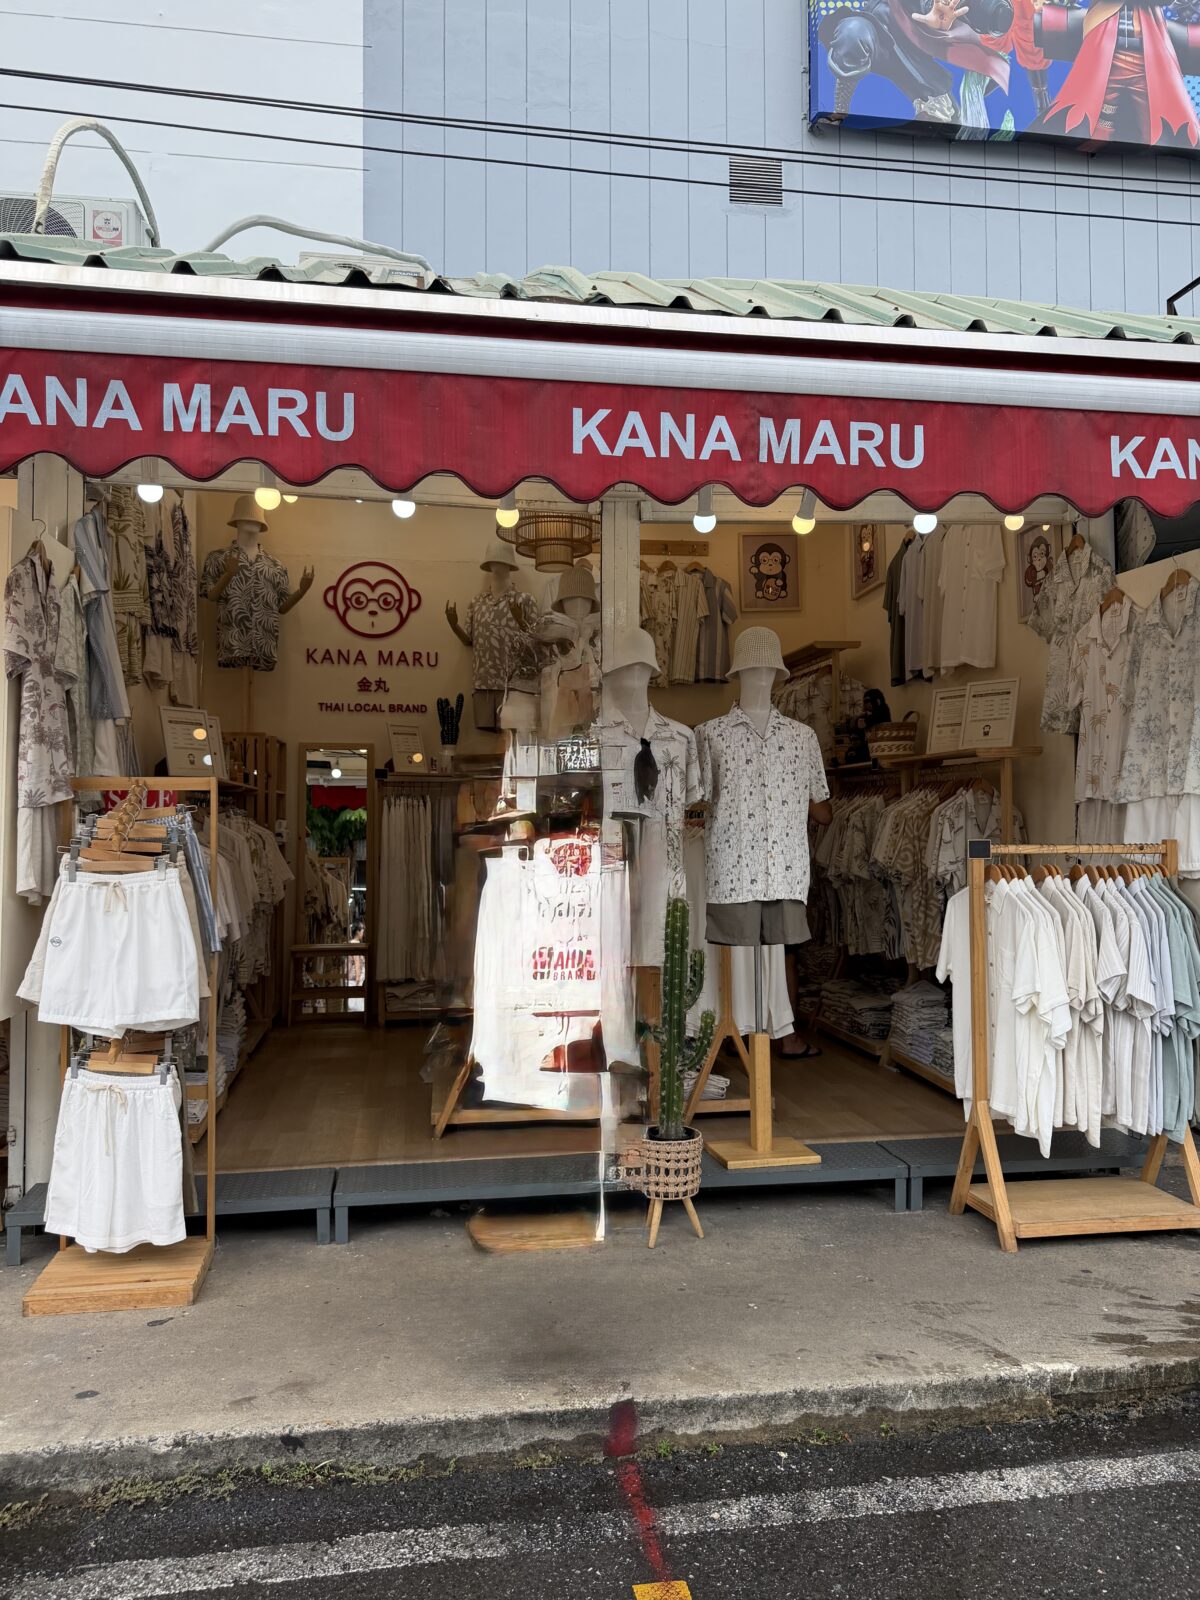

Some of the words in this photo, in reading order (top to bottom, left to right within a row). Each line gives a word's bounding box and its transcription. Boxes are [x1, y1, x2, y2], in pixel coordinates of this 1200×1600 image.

[0, 374, 142, 431] ANA
[163, 383, 355, 442] MARU
[572, 407, 741, 462] KANA
[758, 416, 924, 469] MARU
[306, 648, 367, 666] KANA
[378, 650, 439, 668] MARU
[357, 676, 390, 693] 金丸
[318, 702, 344, 712] THAI
[348, 703, 385, 713] LOCAL
[388, 703, 428, 714] BRAND
[108, 790, 175, 810] SLE
